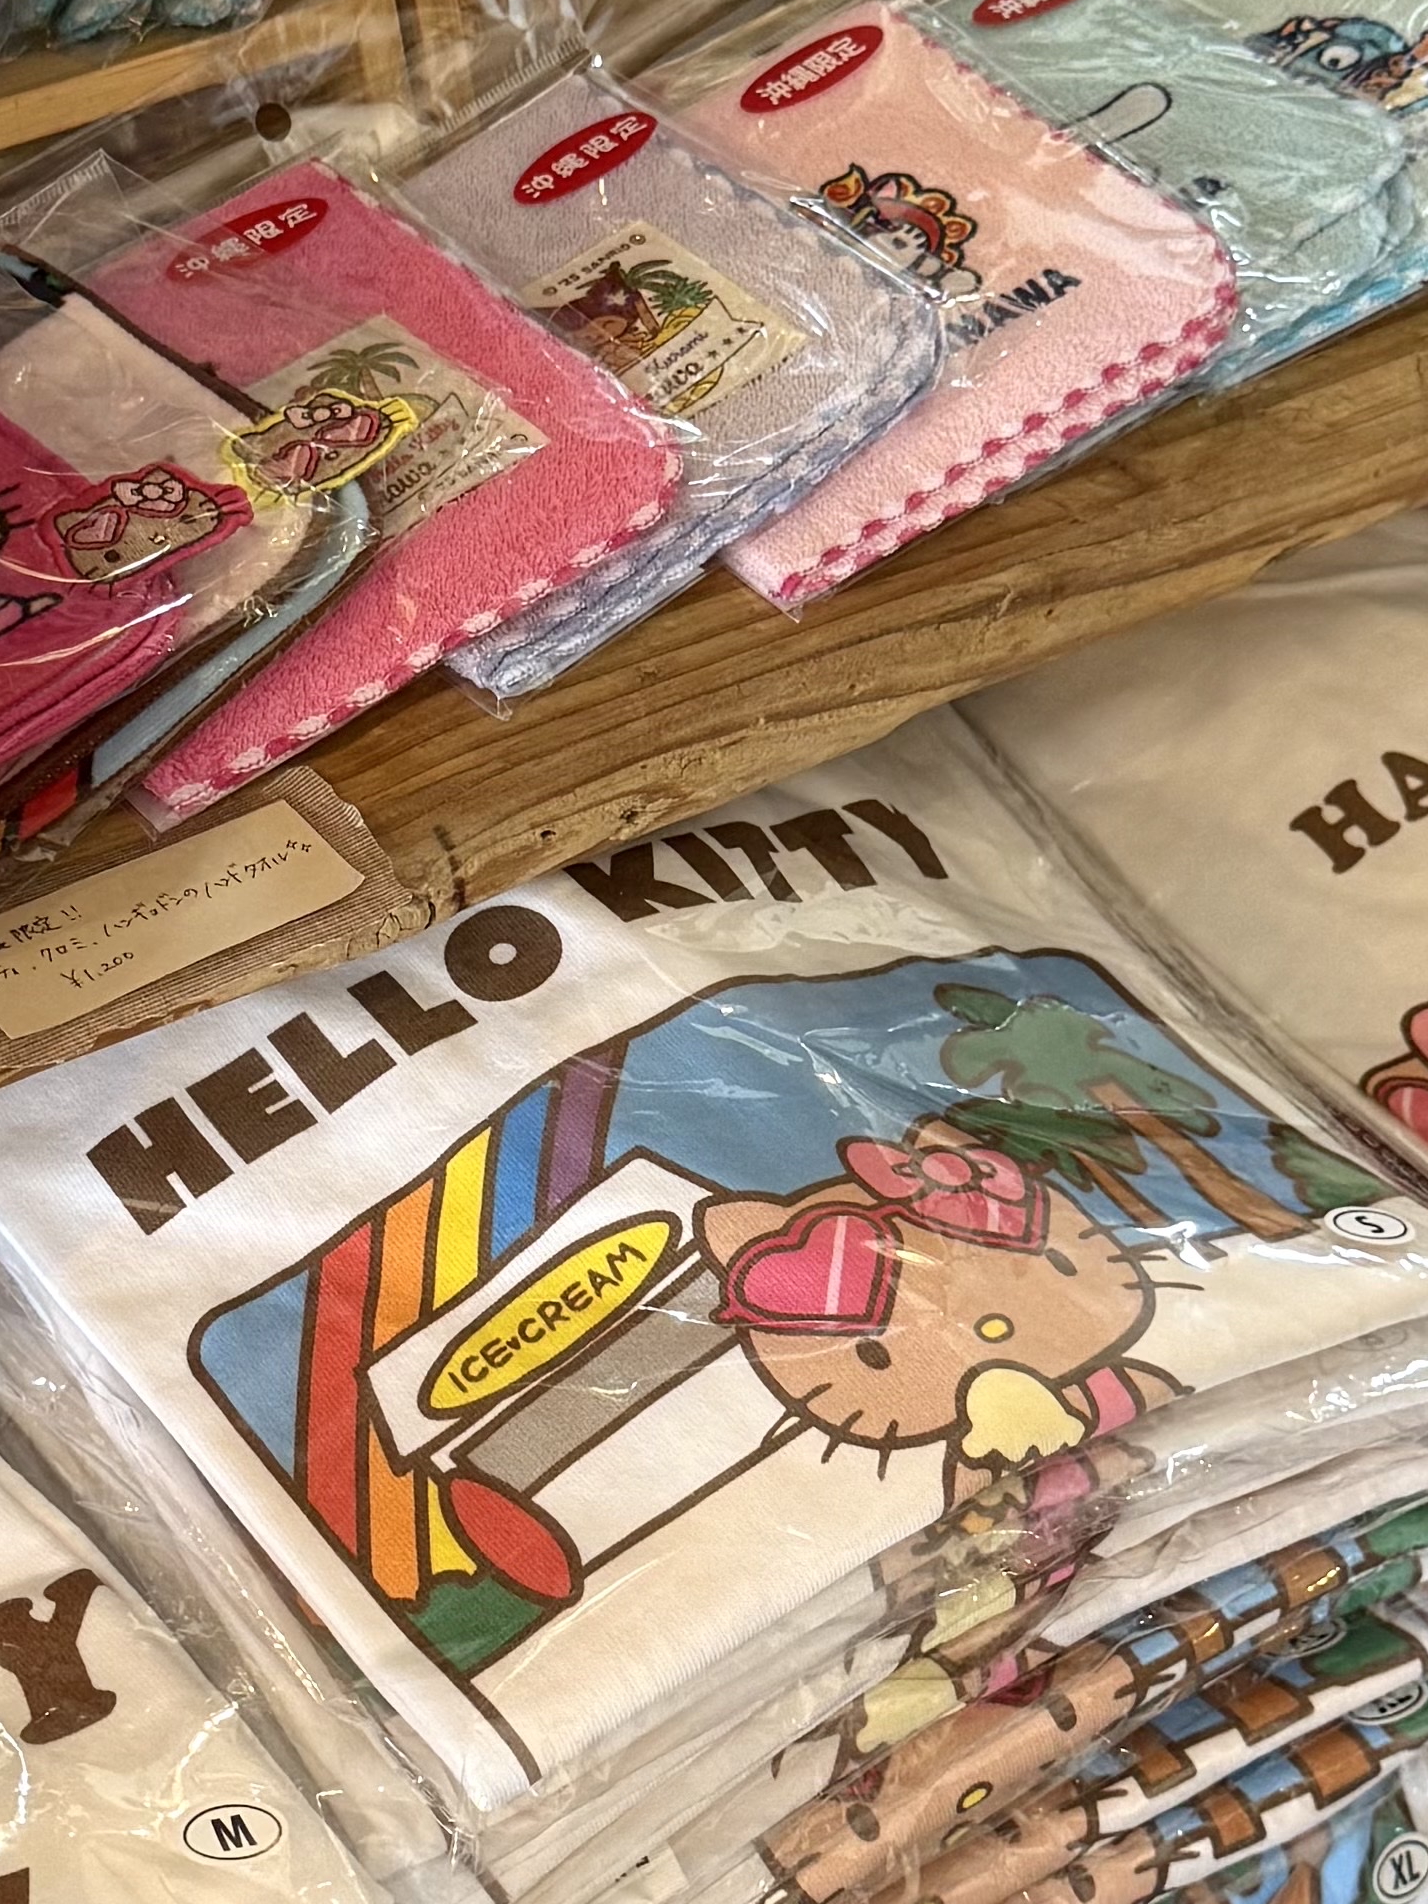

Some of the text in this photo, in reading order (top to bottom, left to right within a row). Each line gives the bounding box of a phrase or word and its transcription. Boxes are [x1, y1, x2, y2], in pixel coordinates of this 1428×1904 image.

[753, 34, 867, 109] 沖縄限定
[523, 116, 649, 204] 沖縄限定
[173, 201, 319, 278] 沖縄限定
[945, 268, 1082, 348] NAWA
[387, 460, 437, 503] awa
[83, 797, 953, 1239] HELLO KITTY
[444, 1236, 648, 1398] ICE CREAM
[206, 1813, 254, 1853] M
[1390, 1845, 1422, 1891] XL
